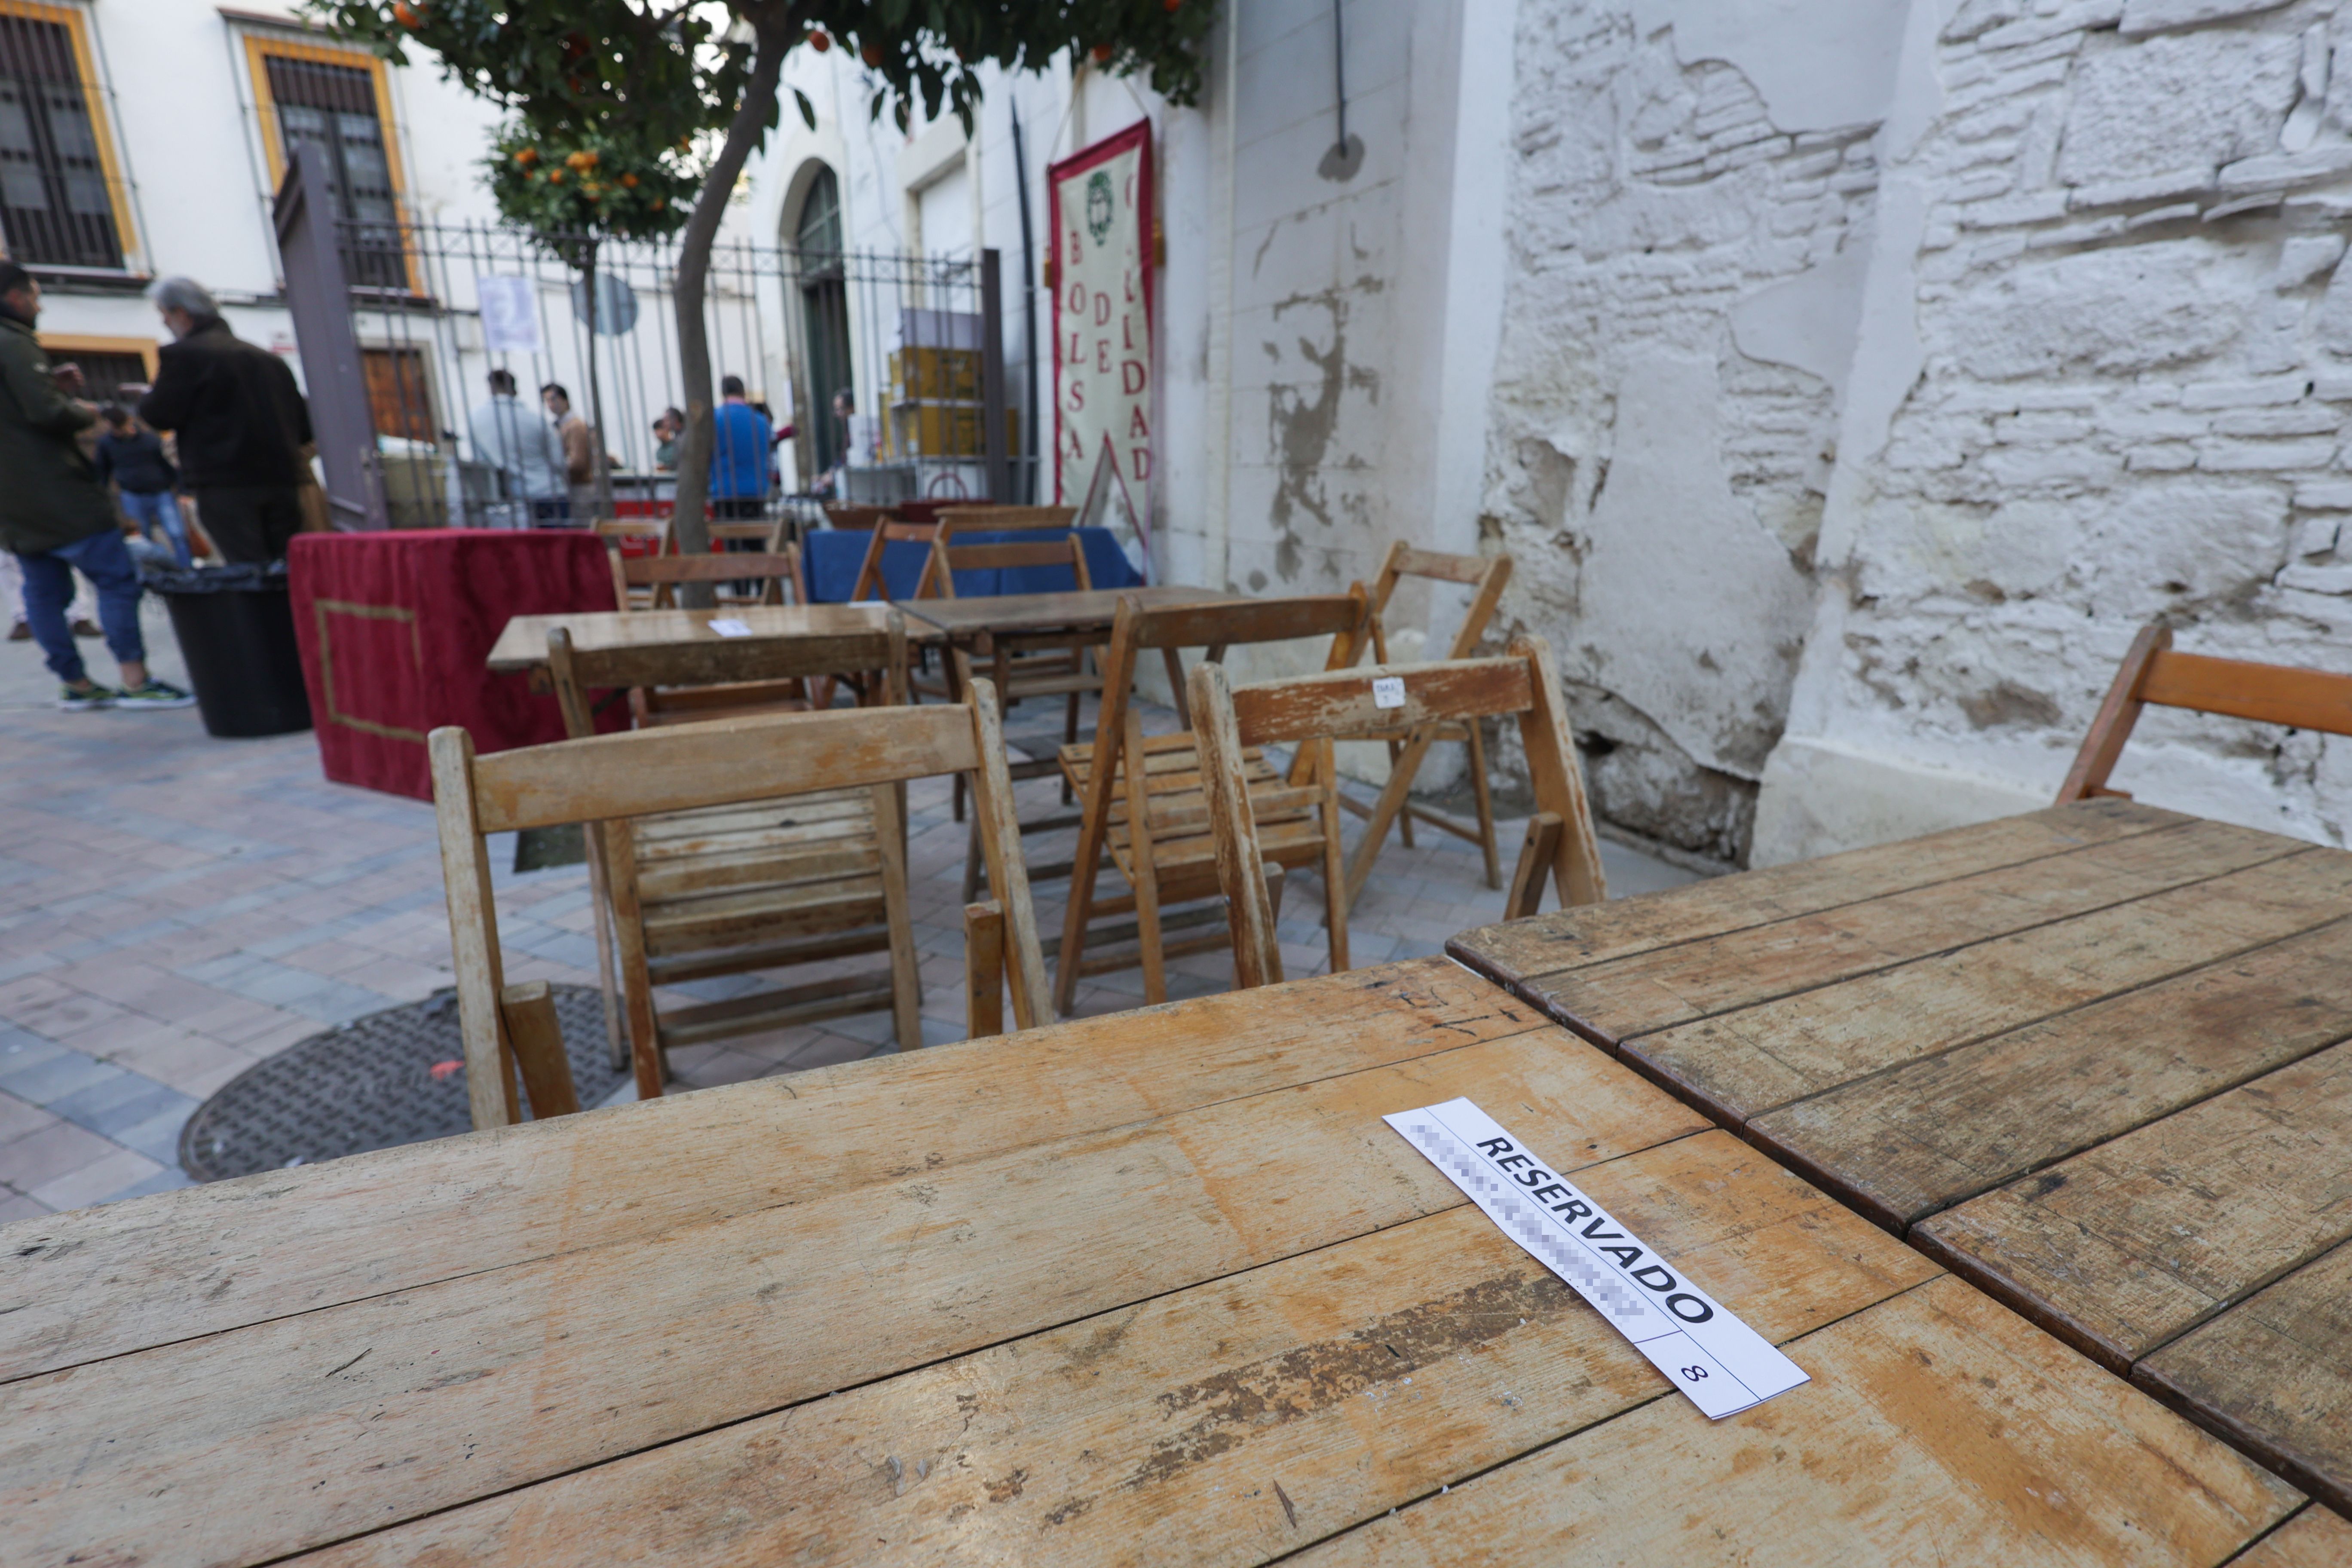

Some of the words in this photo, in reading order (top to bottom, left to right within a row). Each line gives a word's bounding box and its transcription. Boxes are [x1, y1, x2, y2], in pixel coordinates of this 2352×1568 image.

[1067, 230, 1086, 459] BOLSA
[1094, 292, 1111, 374] DE
[1476, 1137, 1714, 1323] RESERVADO
[1681, 1365, 1709, 1382] 8
